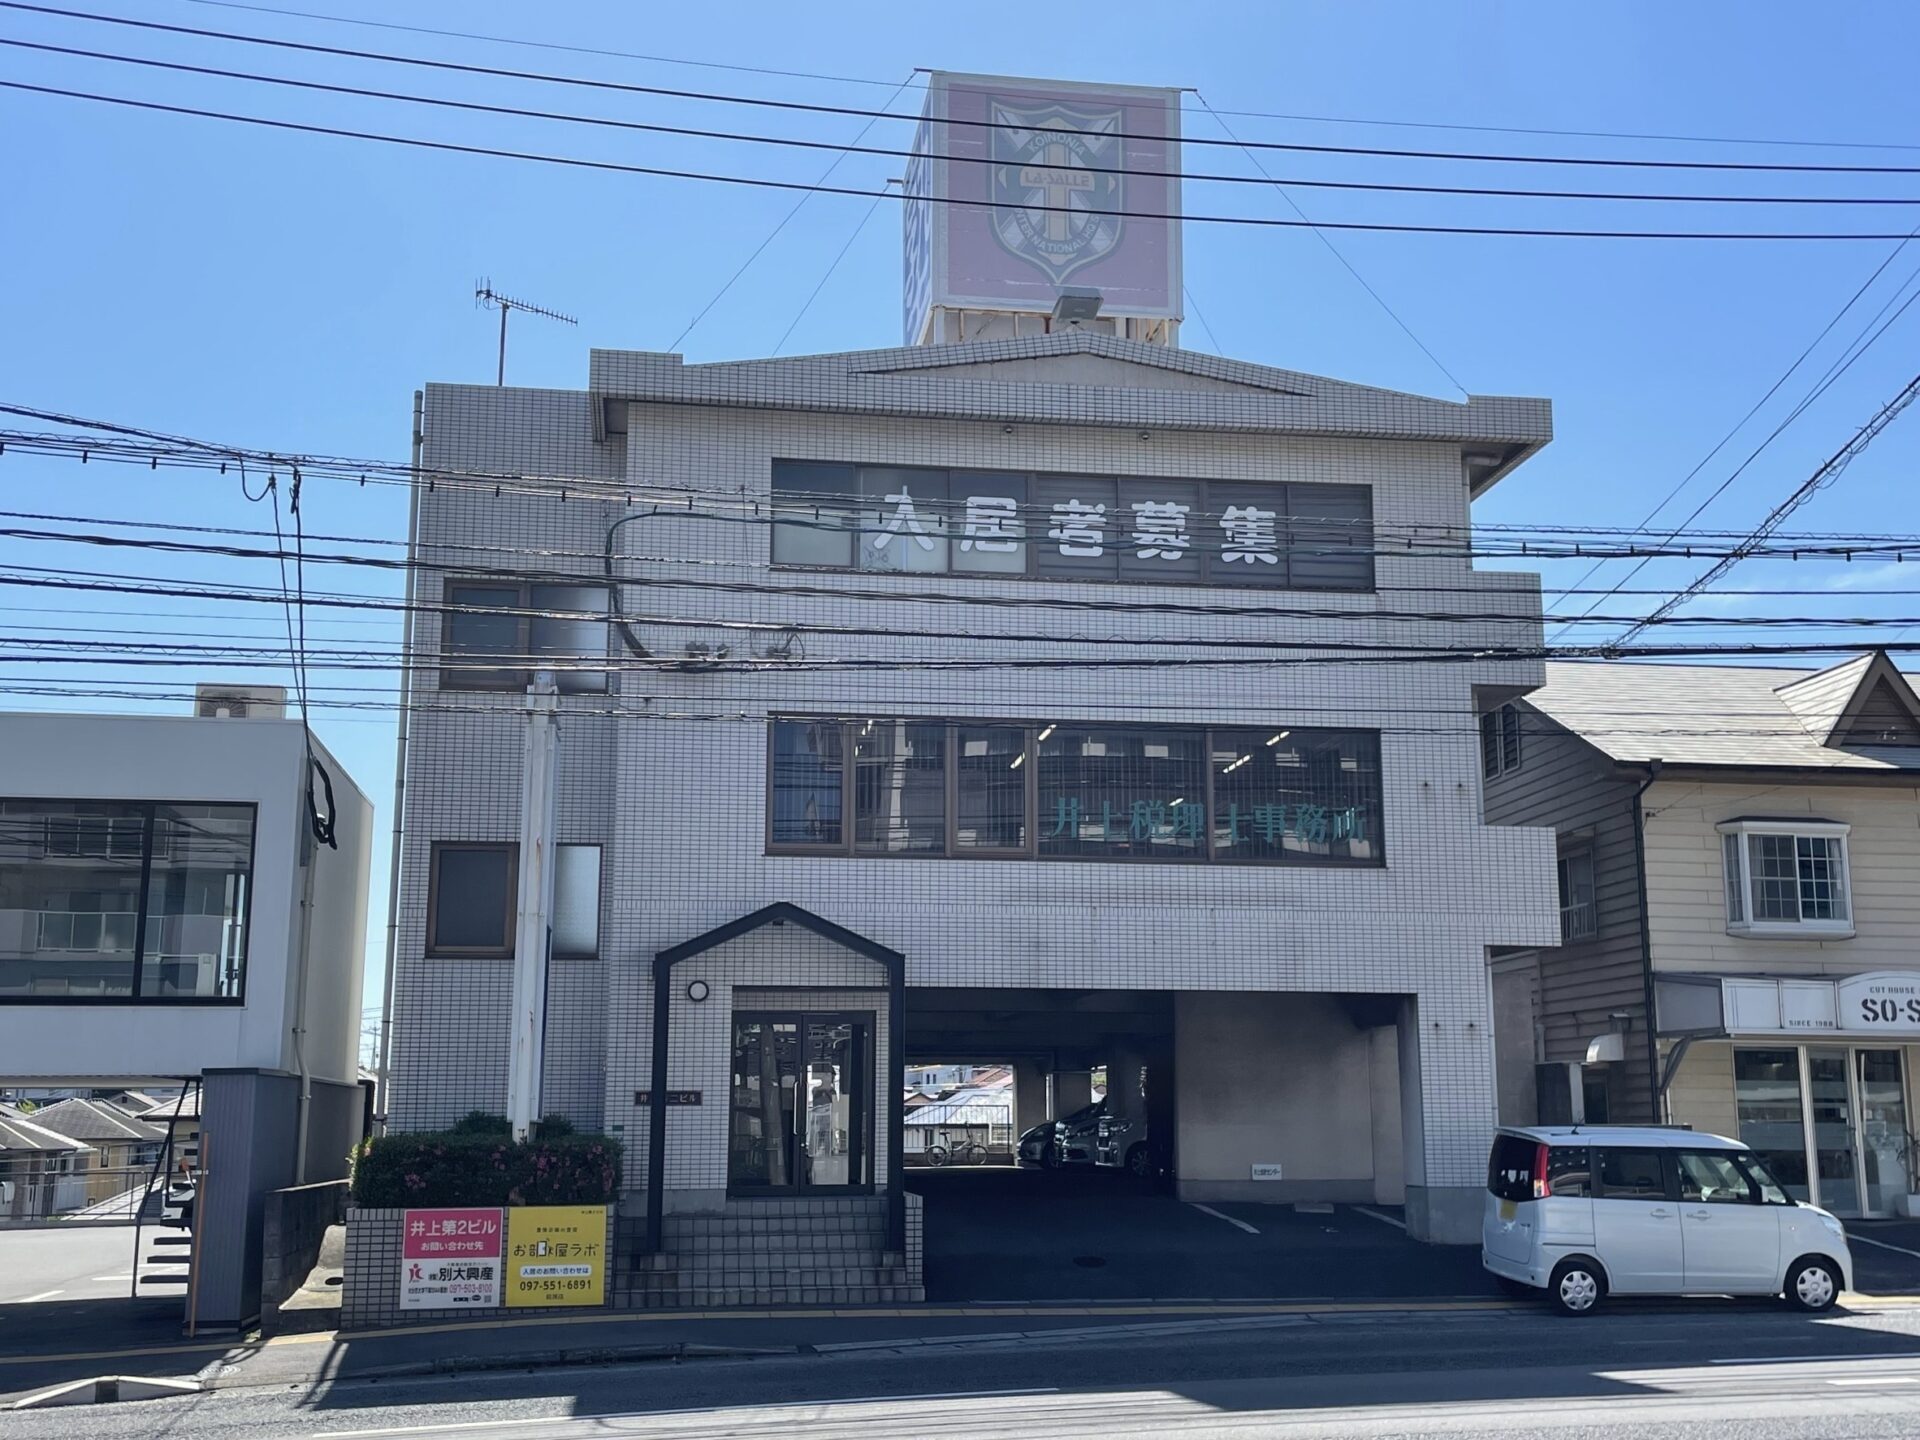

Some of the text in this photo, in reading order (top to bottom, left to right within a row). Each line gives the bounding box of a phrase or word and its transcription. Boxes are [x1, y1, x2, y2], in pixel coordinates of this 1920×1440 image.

[873, 489, 1279, 564] 入居者募集
[1051, 797, 1367, 844] 井上税理士事務所
[1869, 986, 1885, 994] CUT
[410, 1219, 497, 1237] 井上第2ビル
[420, 1240, 485, 1251] お問い合わせ先
[519, 1279, 592, 1291] 097-551-6891
